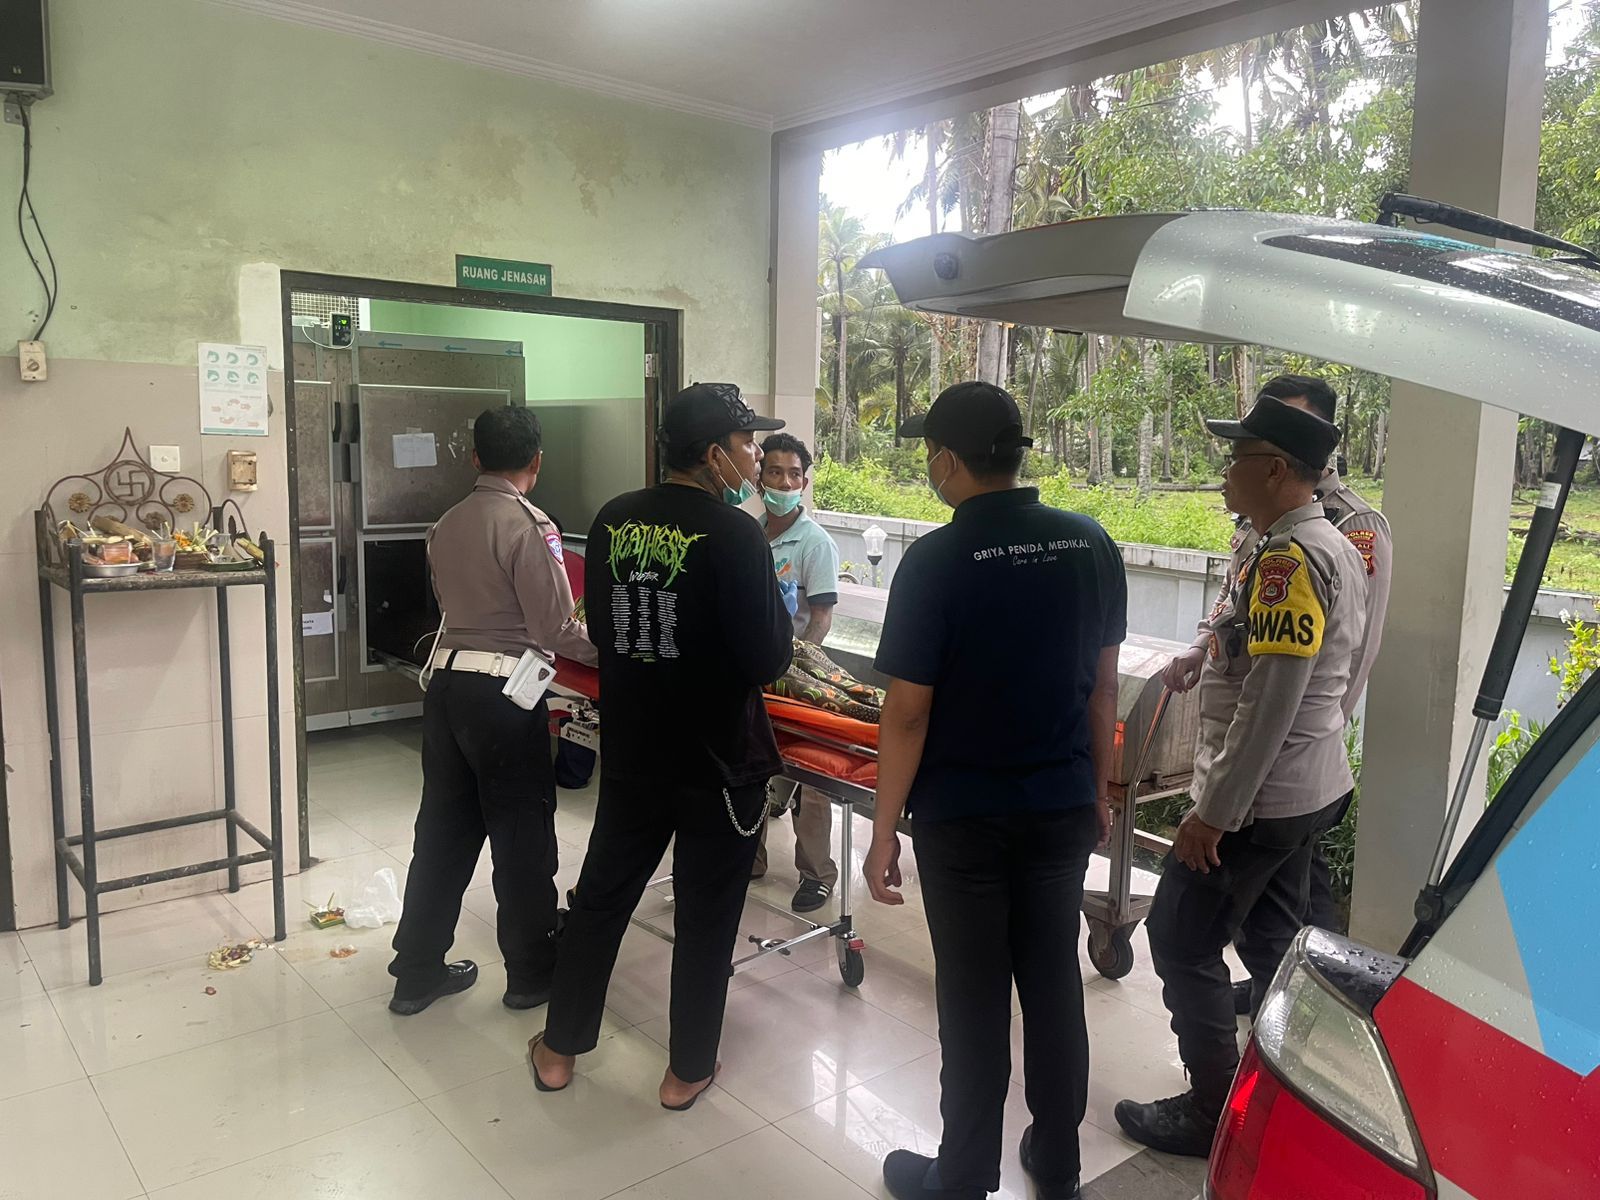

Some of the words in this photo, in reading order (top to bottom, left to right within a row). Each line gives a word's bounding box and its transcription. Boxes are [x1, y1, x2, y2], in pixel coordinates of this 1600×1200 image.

[462, 265, 498, 280] RUANG
[501, 270, 547, 286] JENASAH
[973, 546, 1005, 561] GRIYA
[1008, 543, 1044, 555] PENIDA
[1048, 538, 1091, 551] MEDIKAL
